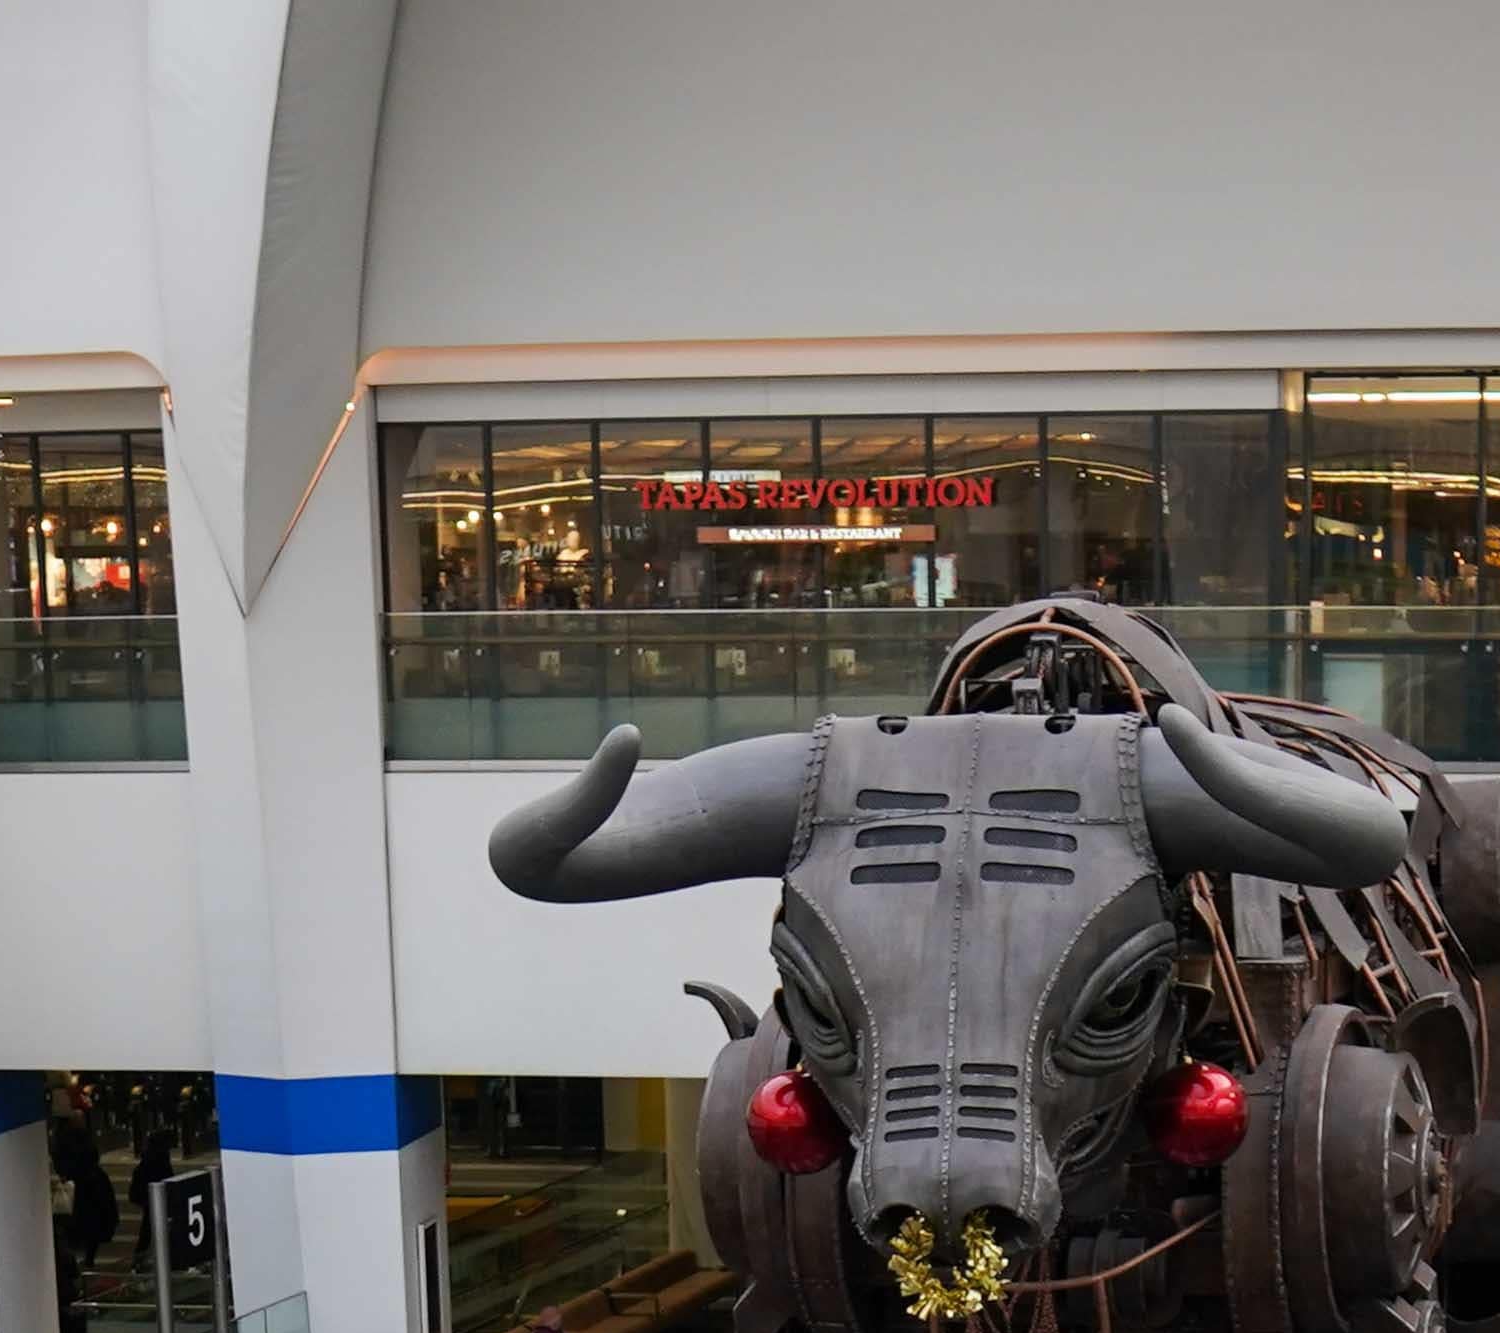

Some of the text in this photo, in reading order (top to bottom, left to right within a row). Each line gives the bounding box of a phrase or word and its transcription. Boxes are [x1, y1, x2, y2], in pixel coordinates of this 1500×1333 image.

[635, 476, 997, 510] TAPAS REVOLUTION
[820, 527, 902, 540] RESTAURANT
[187, 1194, 205, 1247] 5
